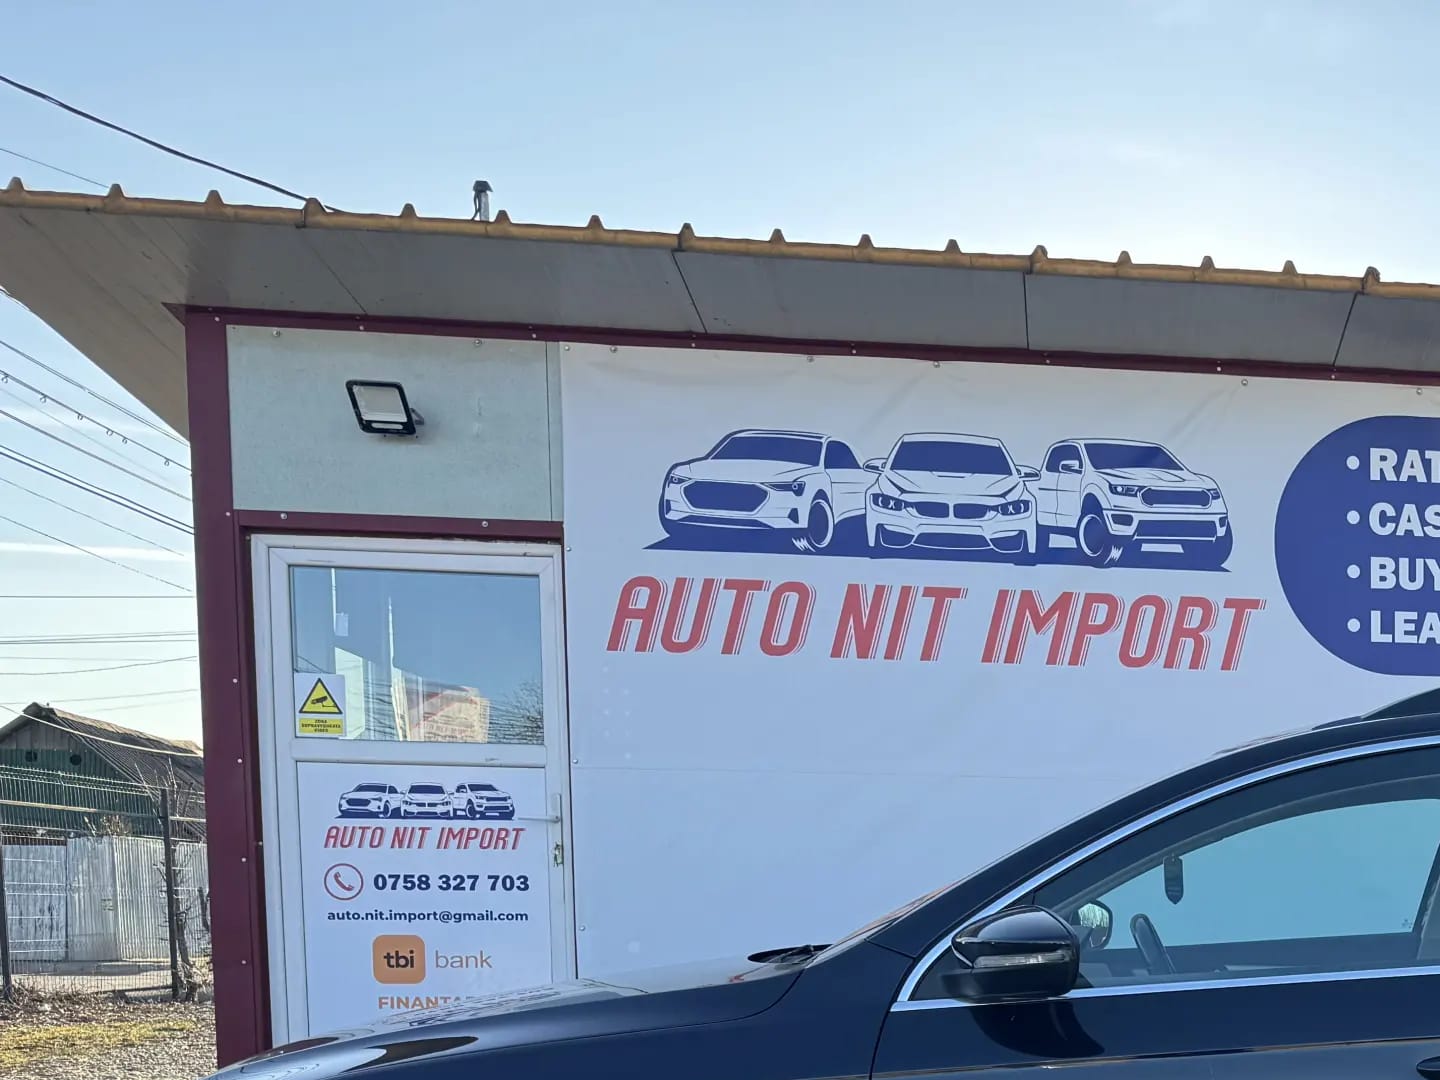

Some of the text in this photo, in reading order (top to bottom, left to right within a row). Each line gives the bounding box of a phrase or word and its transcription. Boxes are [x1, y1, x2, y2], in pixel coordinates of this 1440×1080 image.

[606, 575, 1266, 671] AUTO NIT IMPORT
[324, 826, 526, 850] AUTO NIT IMPORT
[373, 874, 529, 891] 0758 327 703
[327, 909, 529, 923] auto.nit.import@gmail.com
[384, 950, 493, 968] tbi bank
